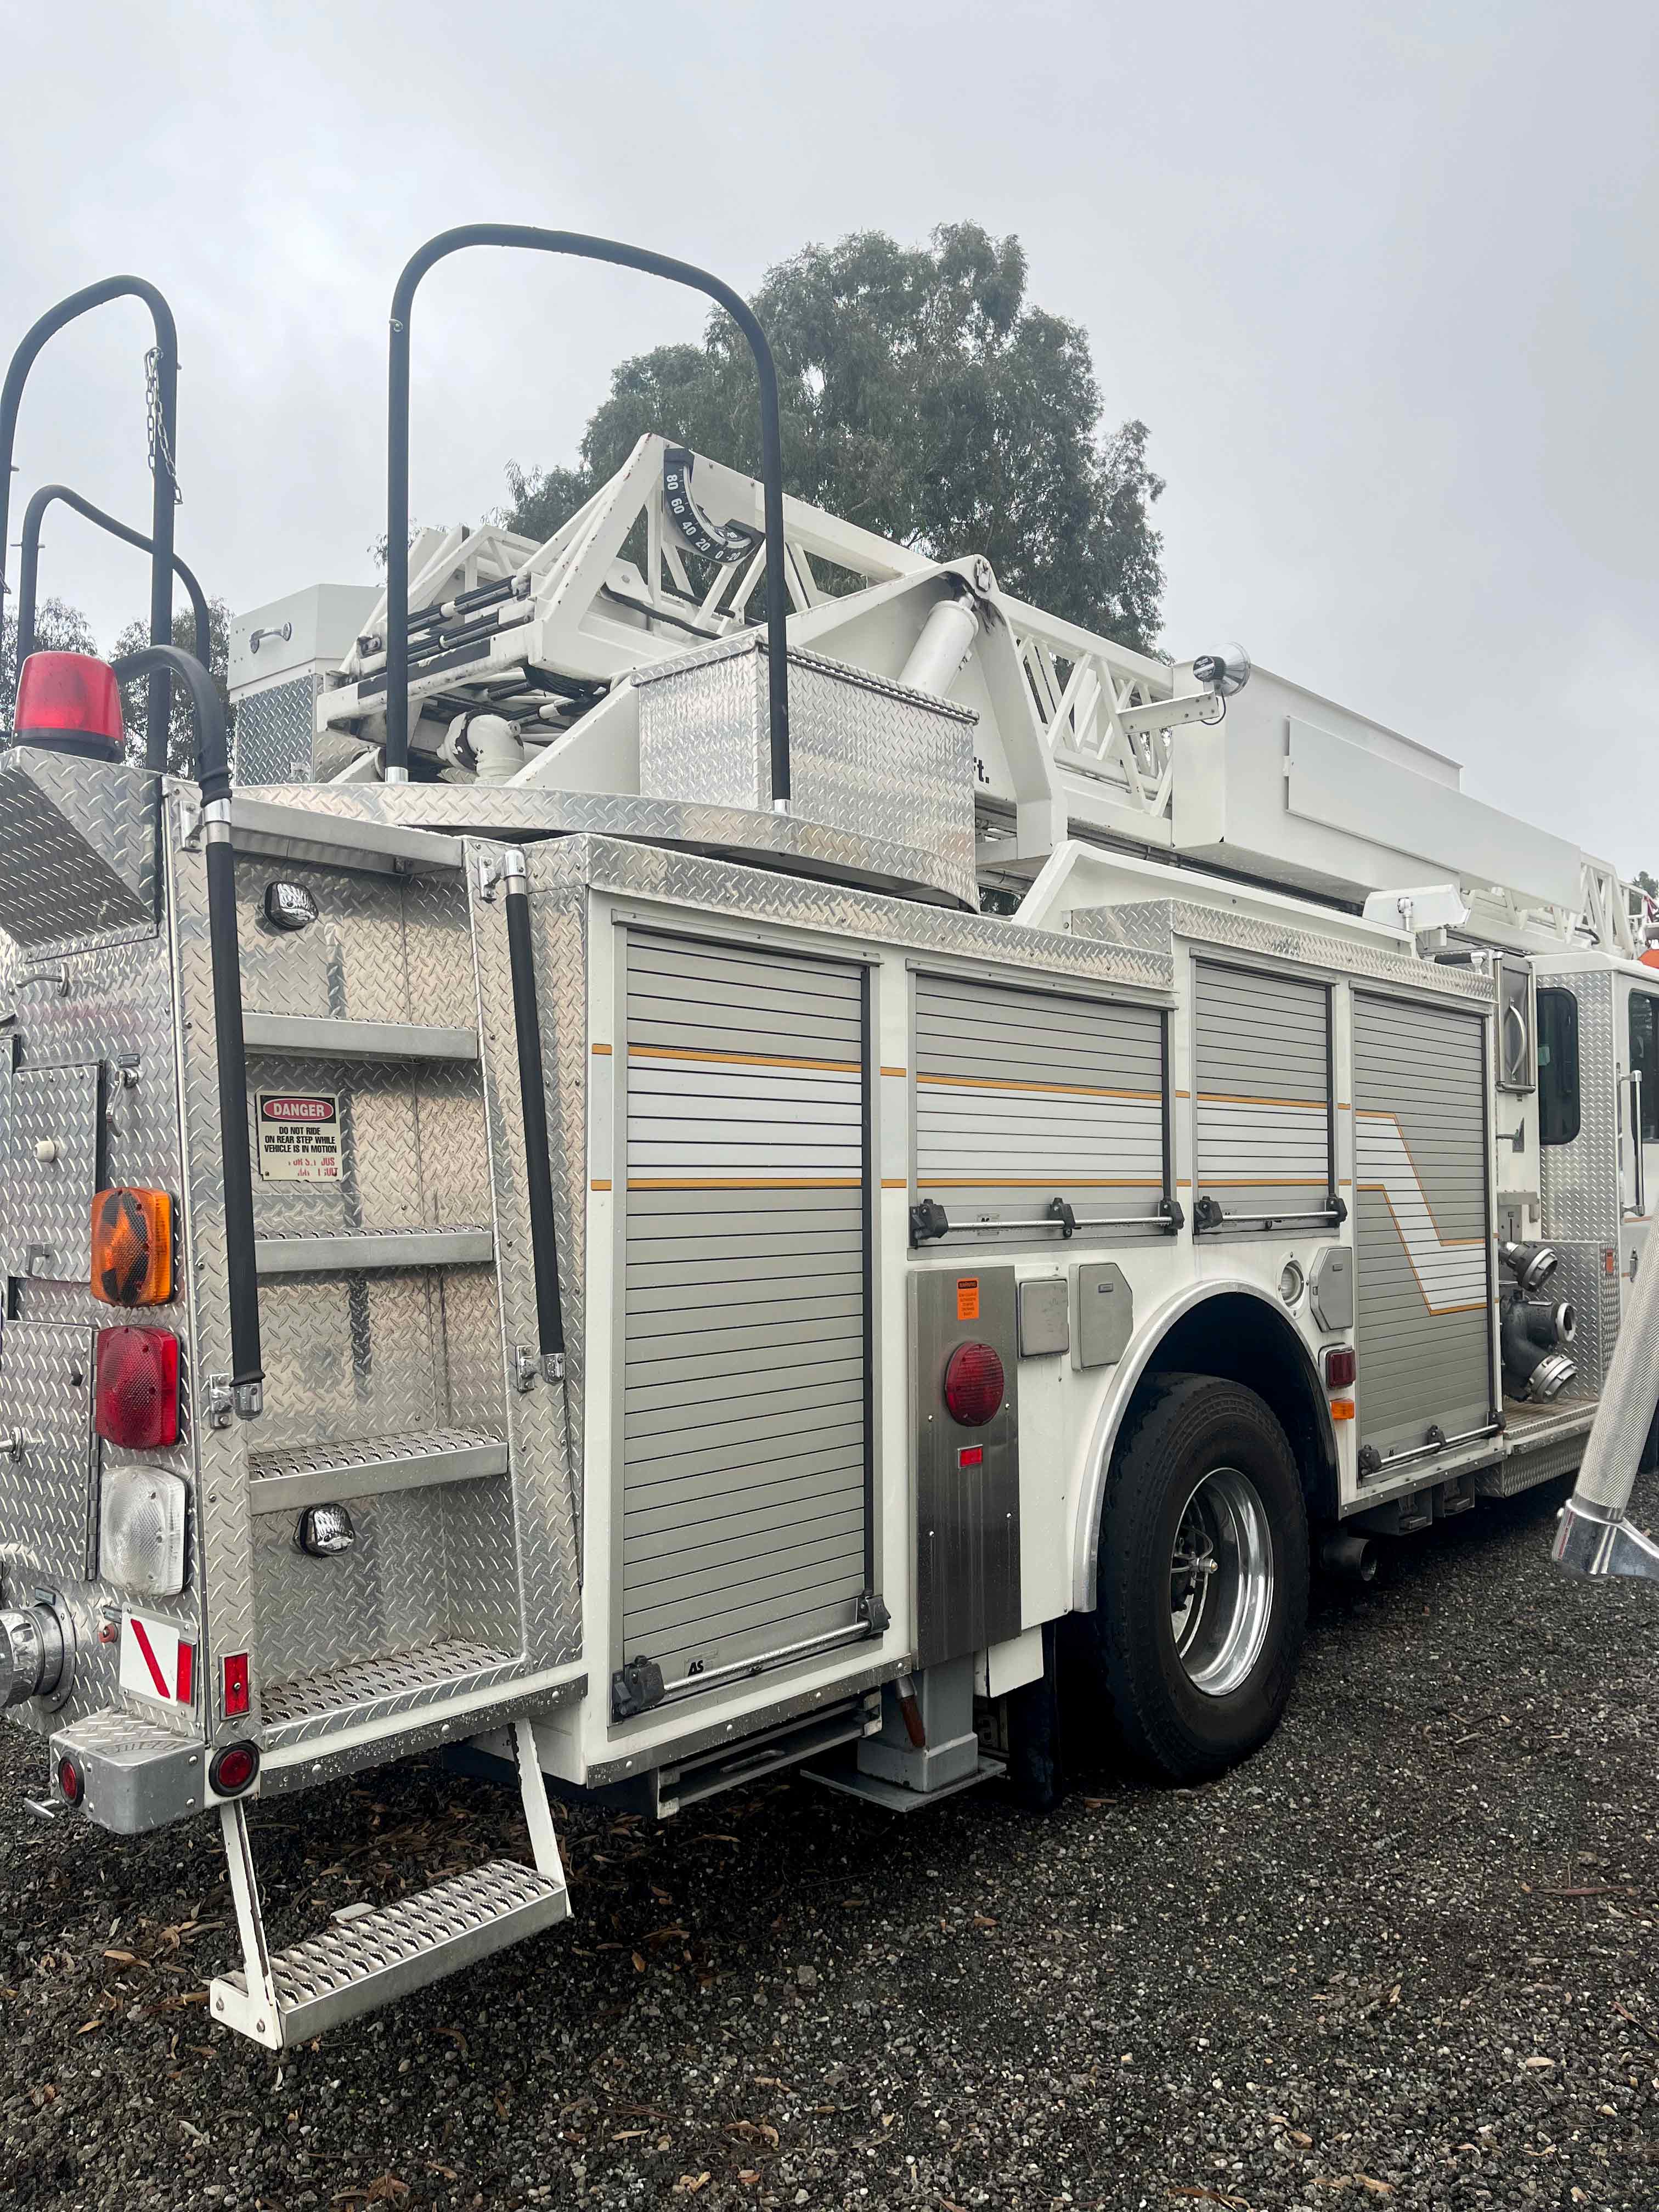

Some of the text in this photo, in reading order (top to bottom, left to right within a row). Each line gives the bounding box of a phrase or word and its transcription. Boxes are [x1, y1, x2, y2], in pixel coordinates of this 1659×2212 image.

[667, 474, 679, 490] 80
[671, 498, 685, 514] 60
[682, 522, 697, 536] 40
[695, 538, 711, 551] 20
[715, 550, 724, 559] 0
[726, 552, 741, 561] -20
[273, 1103, 325, 1117] DANGER
[277, 1136, 294, 1144] REAR
[315, 1136, 335, 1144] WHILE
[264, 1144, 291, 1153] VEHICLE
[687, 1660, 704, 1677] AS
